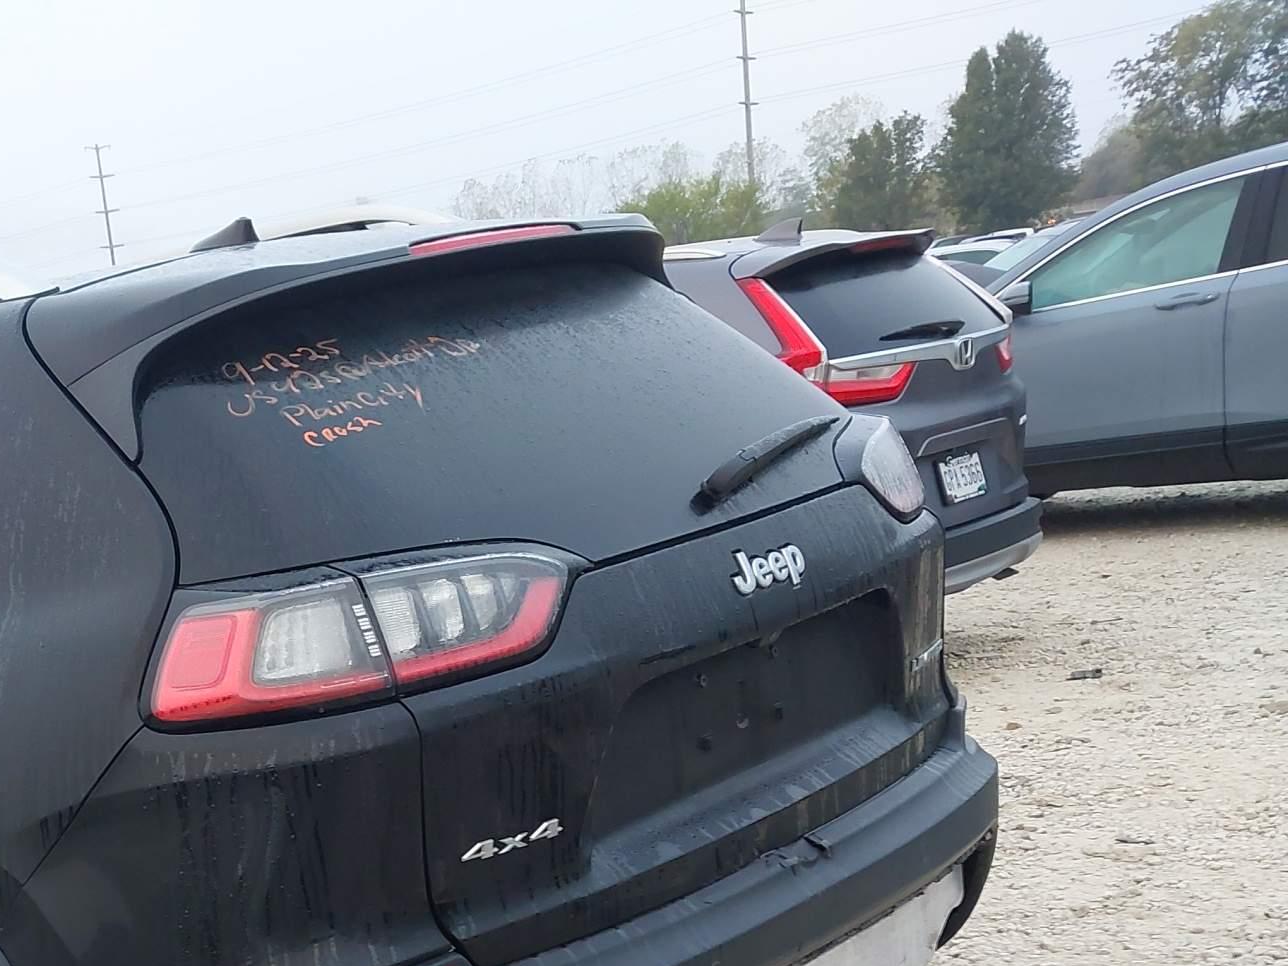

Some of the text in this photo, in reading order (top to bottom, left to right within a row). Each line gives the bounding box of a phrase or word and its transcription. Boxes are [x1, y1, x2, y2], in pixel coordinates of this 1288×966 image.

[222, 338, 340, 385] 9-12-25
[279, 400, 361, 428] Plain
[731, 543, 806, 596] Jeep
[461, 817, 564, 863] 4x4
